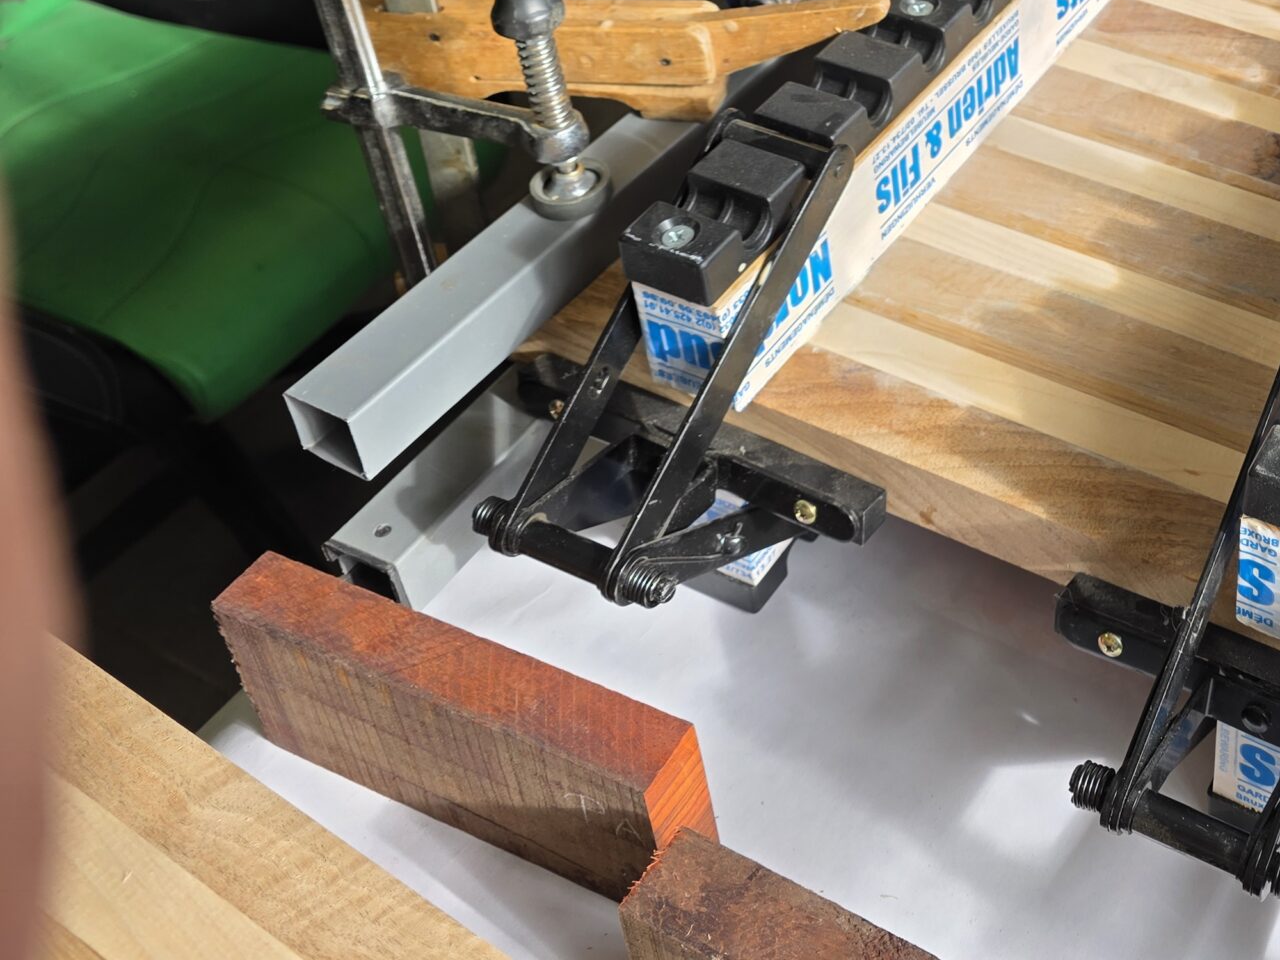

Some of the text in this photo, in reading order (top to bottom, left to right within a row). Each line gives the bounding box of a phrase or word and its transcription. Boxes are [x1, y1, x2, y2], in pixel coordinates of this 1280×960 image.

[874, 38, 1020, 215] Adrien & Fils
[1237, 558, 1277, 606] S
[1238, 743, 1277, 787] S
